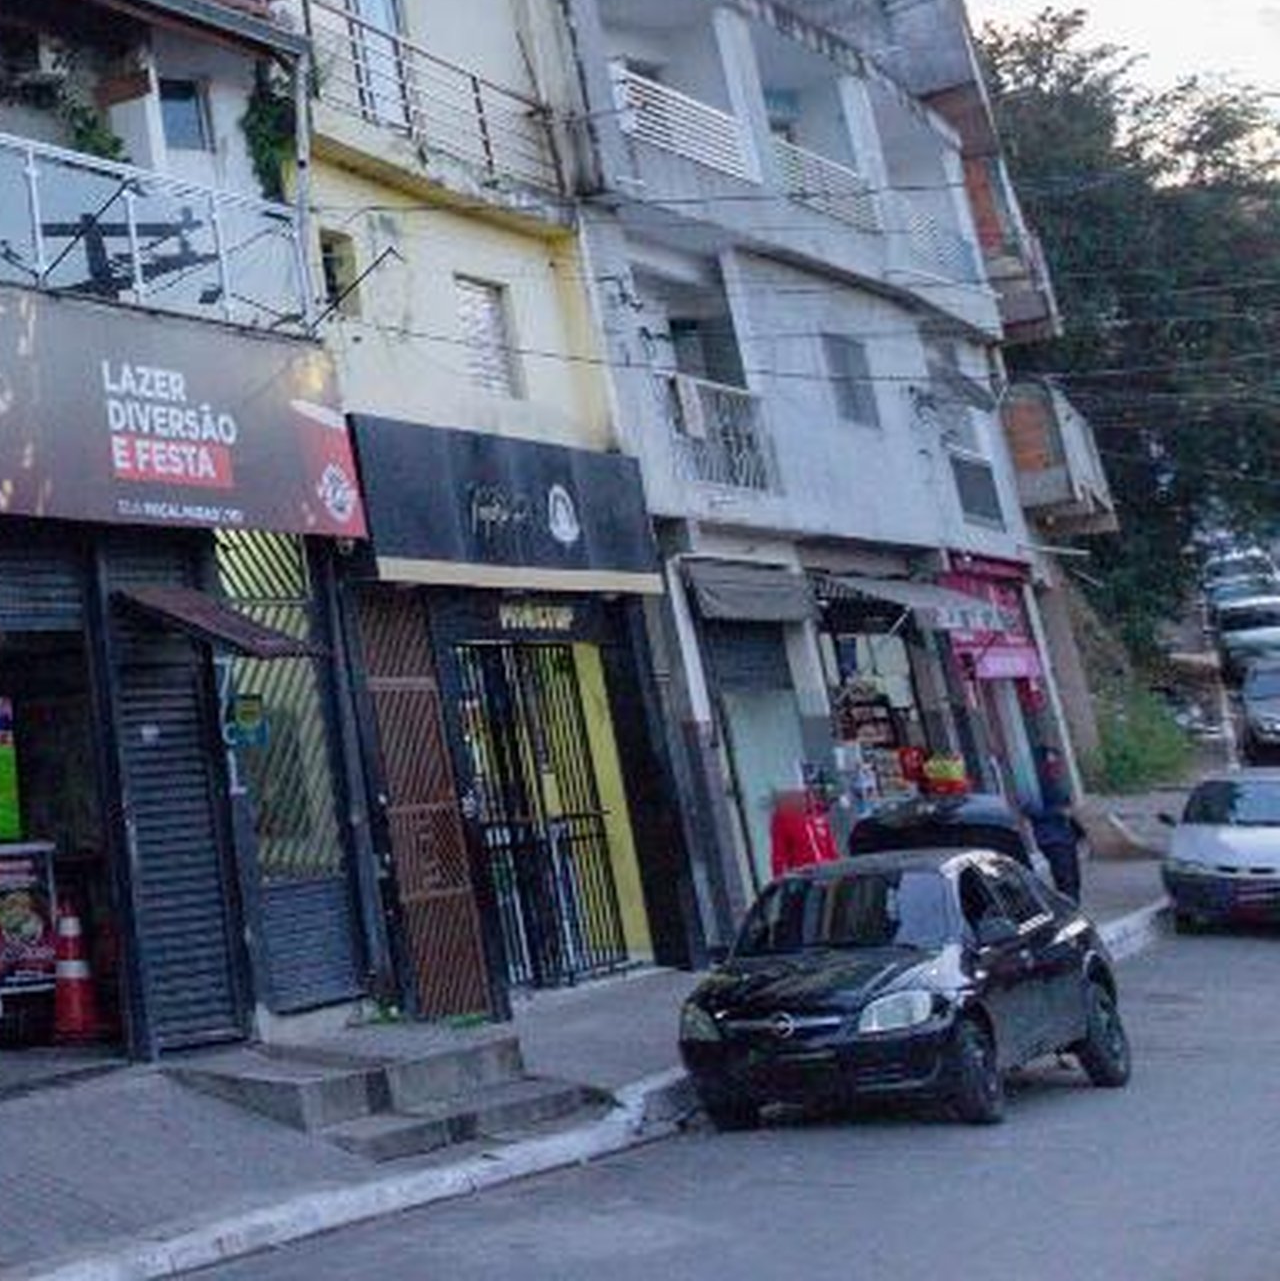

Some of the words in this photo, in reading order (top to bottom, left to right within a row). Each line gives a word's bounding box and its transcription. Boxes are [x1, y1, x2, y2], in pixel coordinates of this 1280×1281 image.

[101, 360, 188, 402] LAZER
[106, 399, 239, 445] DIVERSÃO
[111, 435, 131, 470] E
[135, 440, 217, 479] FESTA
